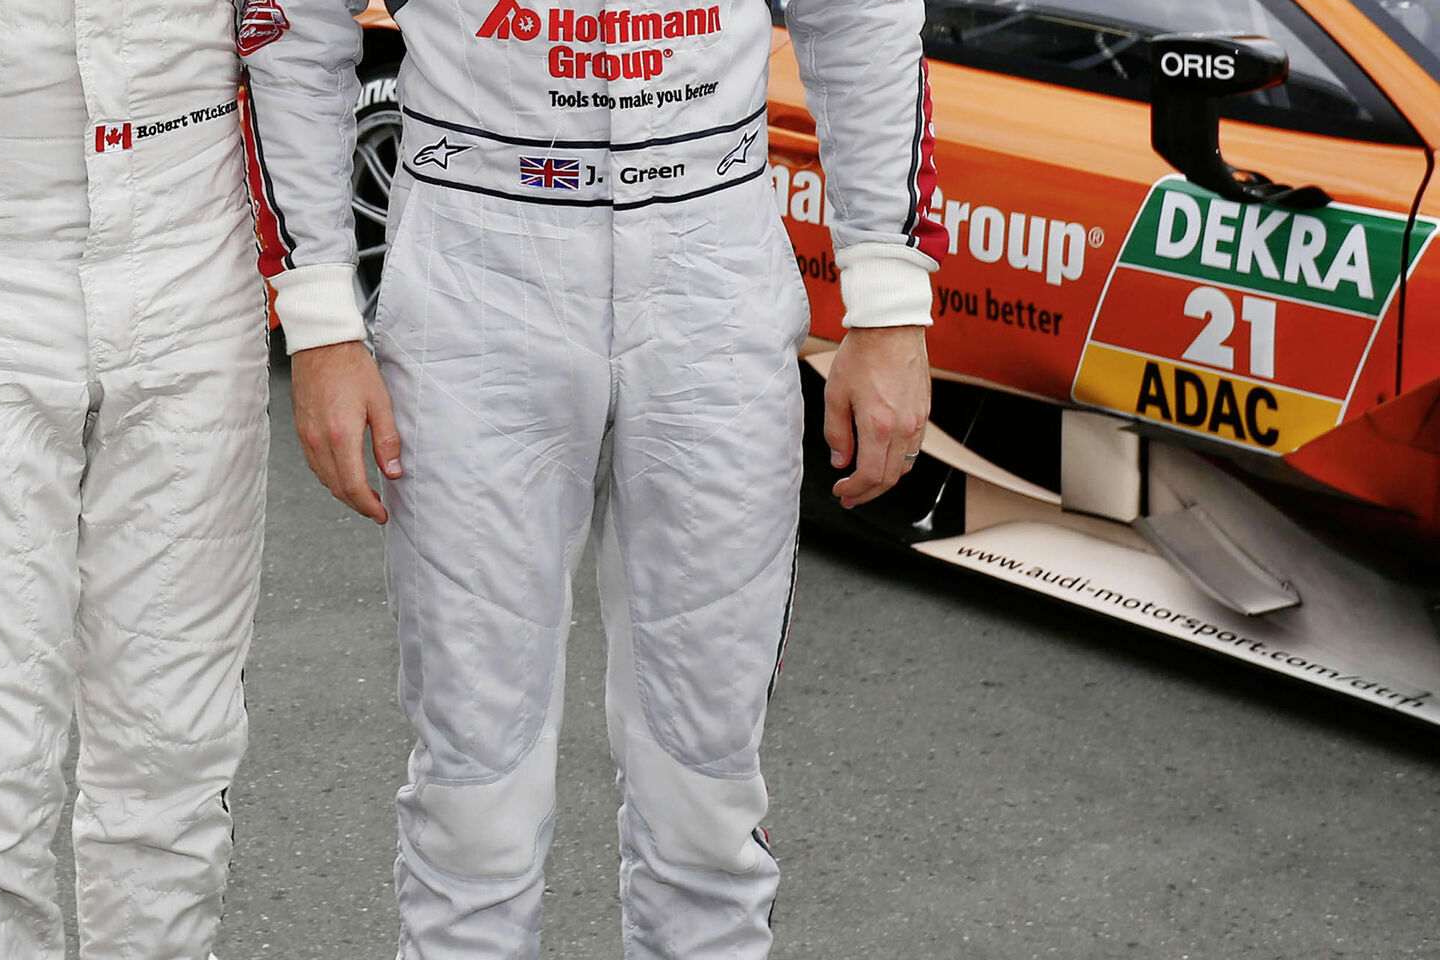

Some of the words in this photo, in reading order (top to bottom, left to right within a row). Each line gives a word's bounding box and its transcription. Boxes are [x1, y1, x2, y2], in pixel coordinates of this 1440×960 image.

[548, 5, 722, 45] Hoffmann
[1160, 52, 1236, 81] ORIS
[548, 90, 589, 108] Tools
[619, 89, 654, 109] make
[656, 89, 682, 108] you
[685, 81, 719, 101] better
[136, 114, 188, 139] Robert
[189, 99, 238, 125] Wicken
[585, 165, 603, 186] J.
[620, 163, 685, 185] Green
[1154, 188, 1375, 300] DEKRA
[797, 251, 837, 283] ools
[937, 284, 978, 317] you
[986, 288, 1062, 336] better
[1180, 286, 1279, 381] 21
[1134, 361, 1279, 446] ADAC
